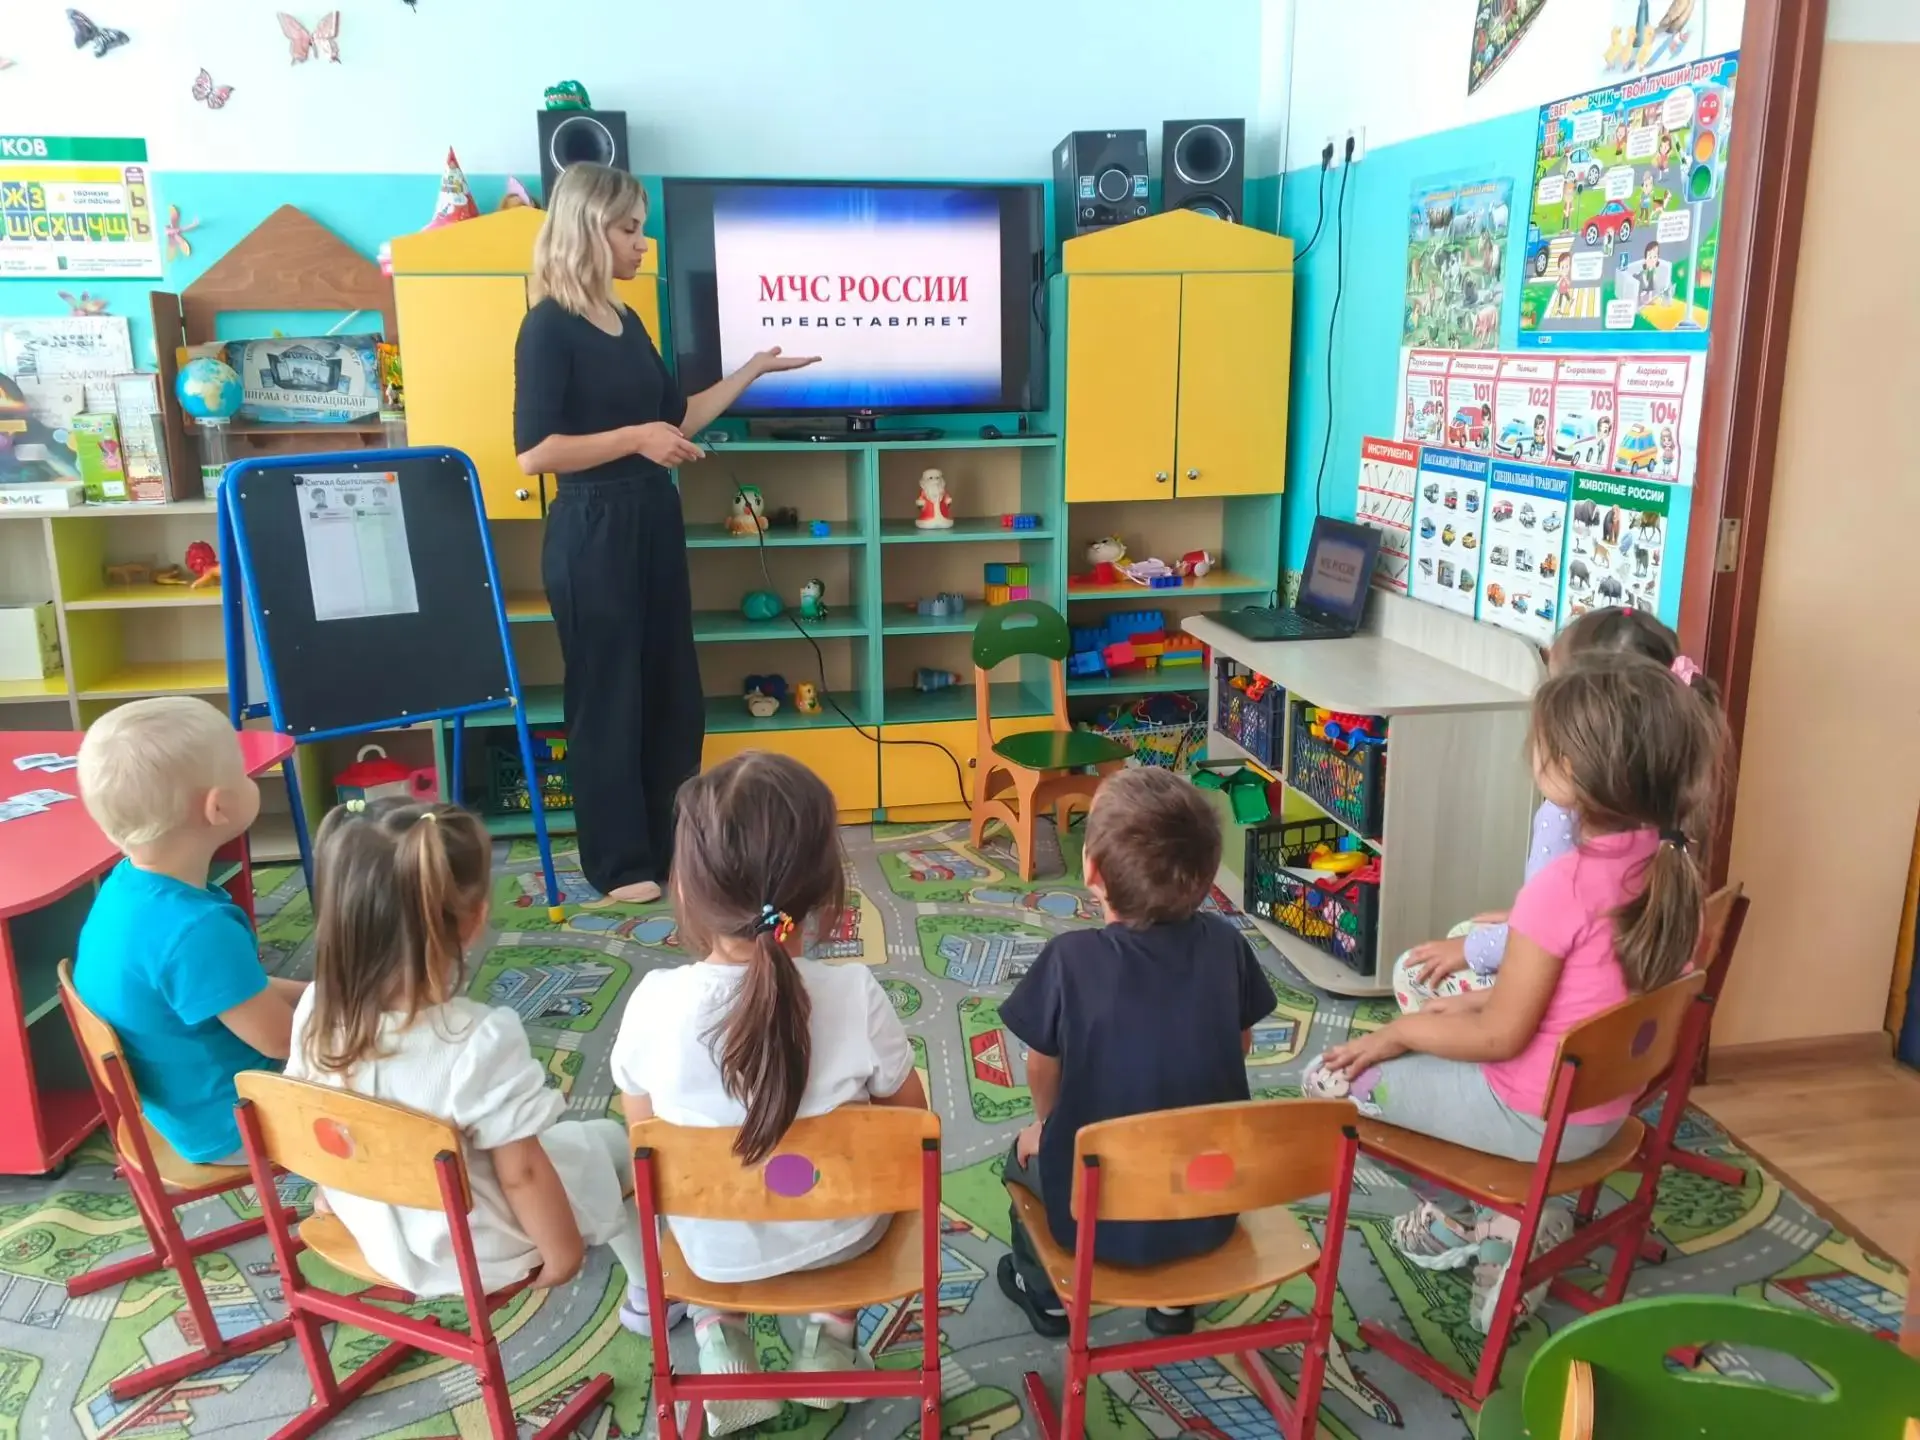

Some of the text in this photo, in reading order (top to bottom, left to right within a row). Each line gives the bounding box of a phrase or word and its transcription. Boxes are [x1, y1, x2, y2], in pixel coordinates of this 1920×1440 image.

[1549, 91, 1612, 118] СВЕТРЧИК
[1622, 78, 1649, 101] ТВОЙ
[1648, 63, 1692, 92] ЛУЧШИЙ
[1693, 59, 1724, 82] ДРУГ
[0, 138, 48, 157] КОВ
[3, 187, 45, 209] Ж З
[7, 216, 129, 238] Ш С Х Ц Ч Щ
[759, 275, 968, 302] МЧС РОССИИ
[762, 316, 968, 328] ПРЕДСТАВЛЯЕТ
[1429, 380, 1444, 397] 112
[1473, 383, 1490, 402] 101
[1528, 387, 1549, 407] 102
[1590, 390, 1612, 411] 103
[1650, 402, 1677, 424] 104
[1535, 475, 1568, 494] ТРАНСПОРТ
[1578, 478, 1665, 503] ЖИВОТНЫЕ РОССИИ
